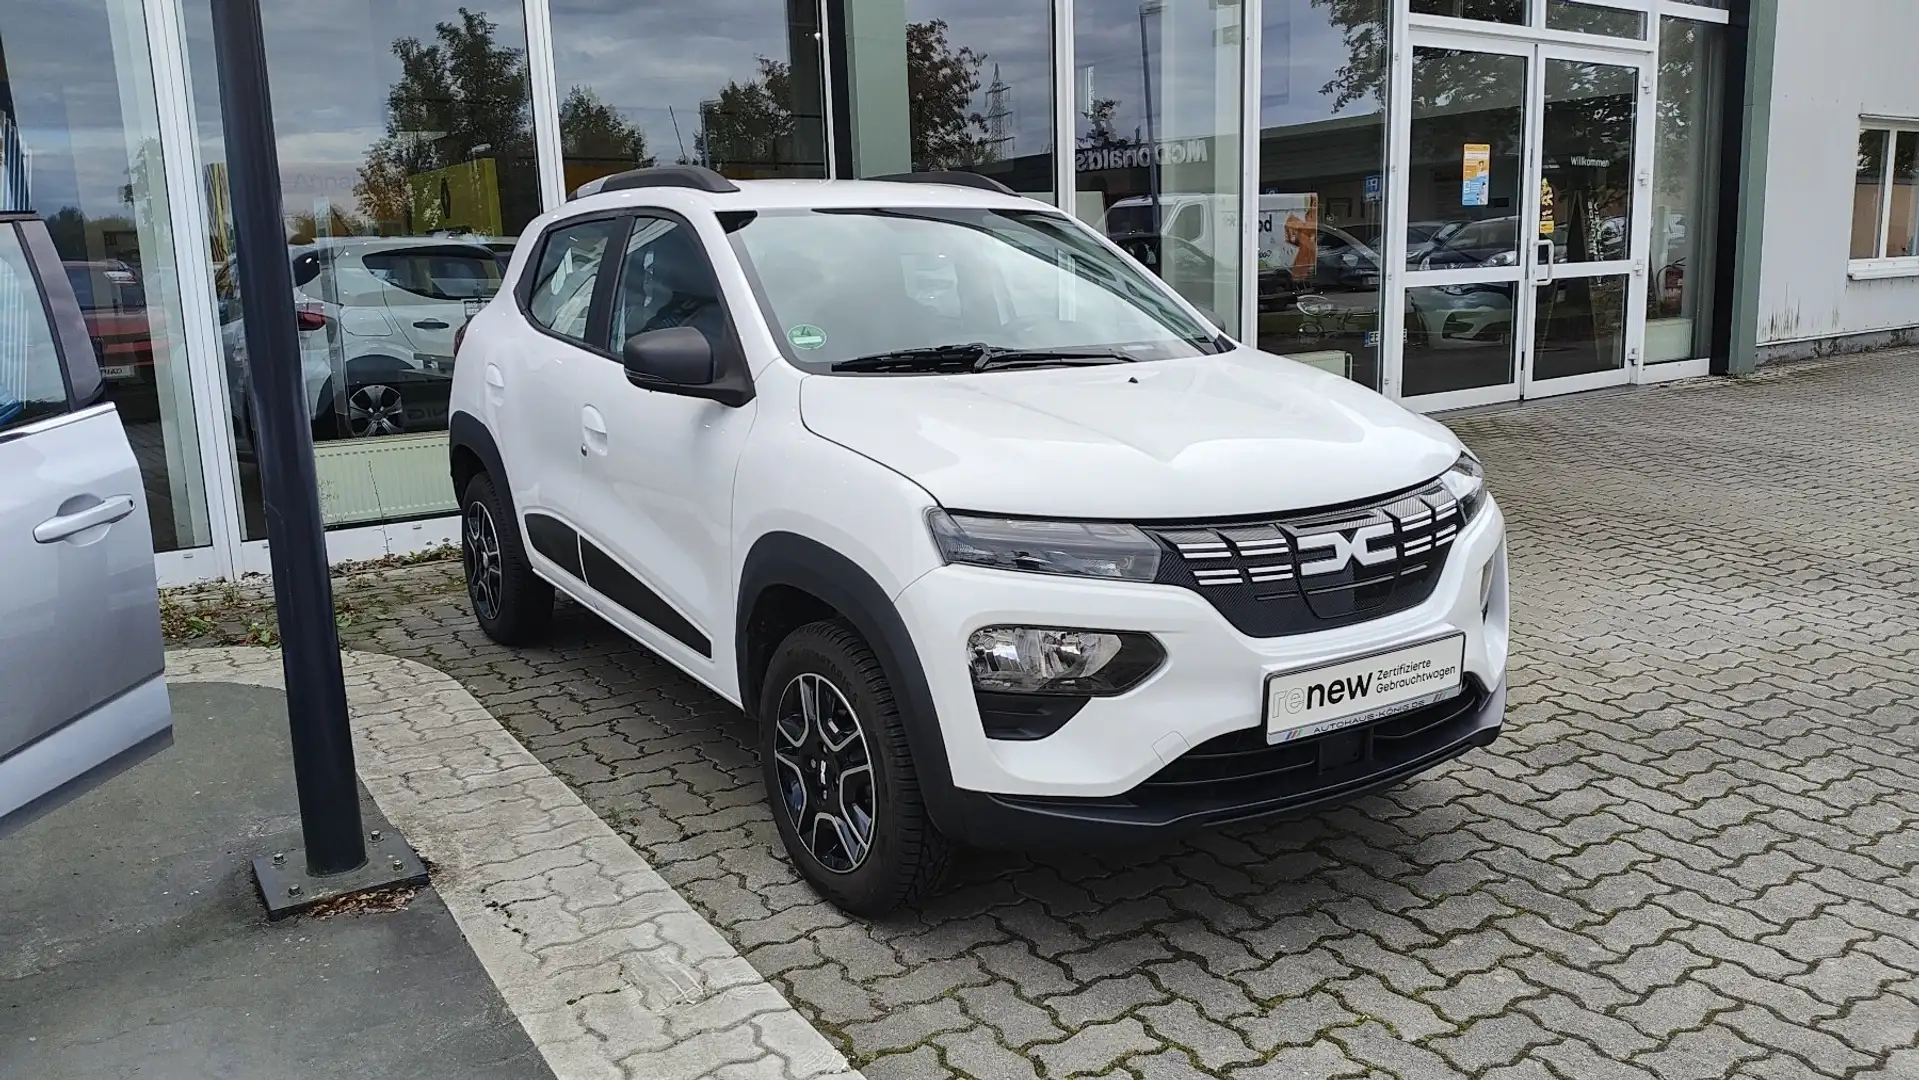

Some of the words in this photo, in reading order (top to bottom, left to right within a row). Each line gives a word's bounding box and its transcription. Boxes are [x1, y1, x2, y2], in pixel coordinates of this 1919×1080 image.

[1570, 155, 1610, 168] Willkommen
[1376, 665, 1456, 694] Gebrauchtwagen
[1377, 659, 1431, 681] Zertifizierte
[1271, 672, 1373, 719] renew
[1313, 699, 1425, 734] AUTOHAUS-KÖNIG.DE
